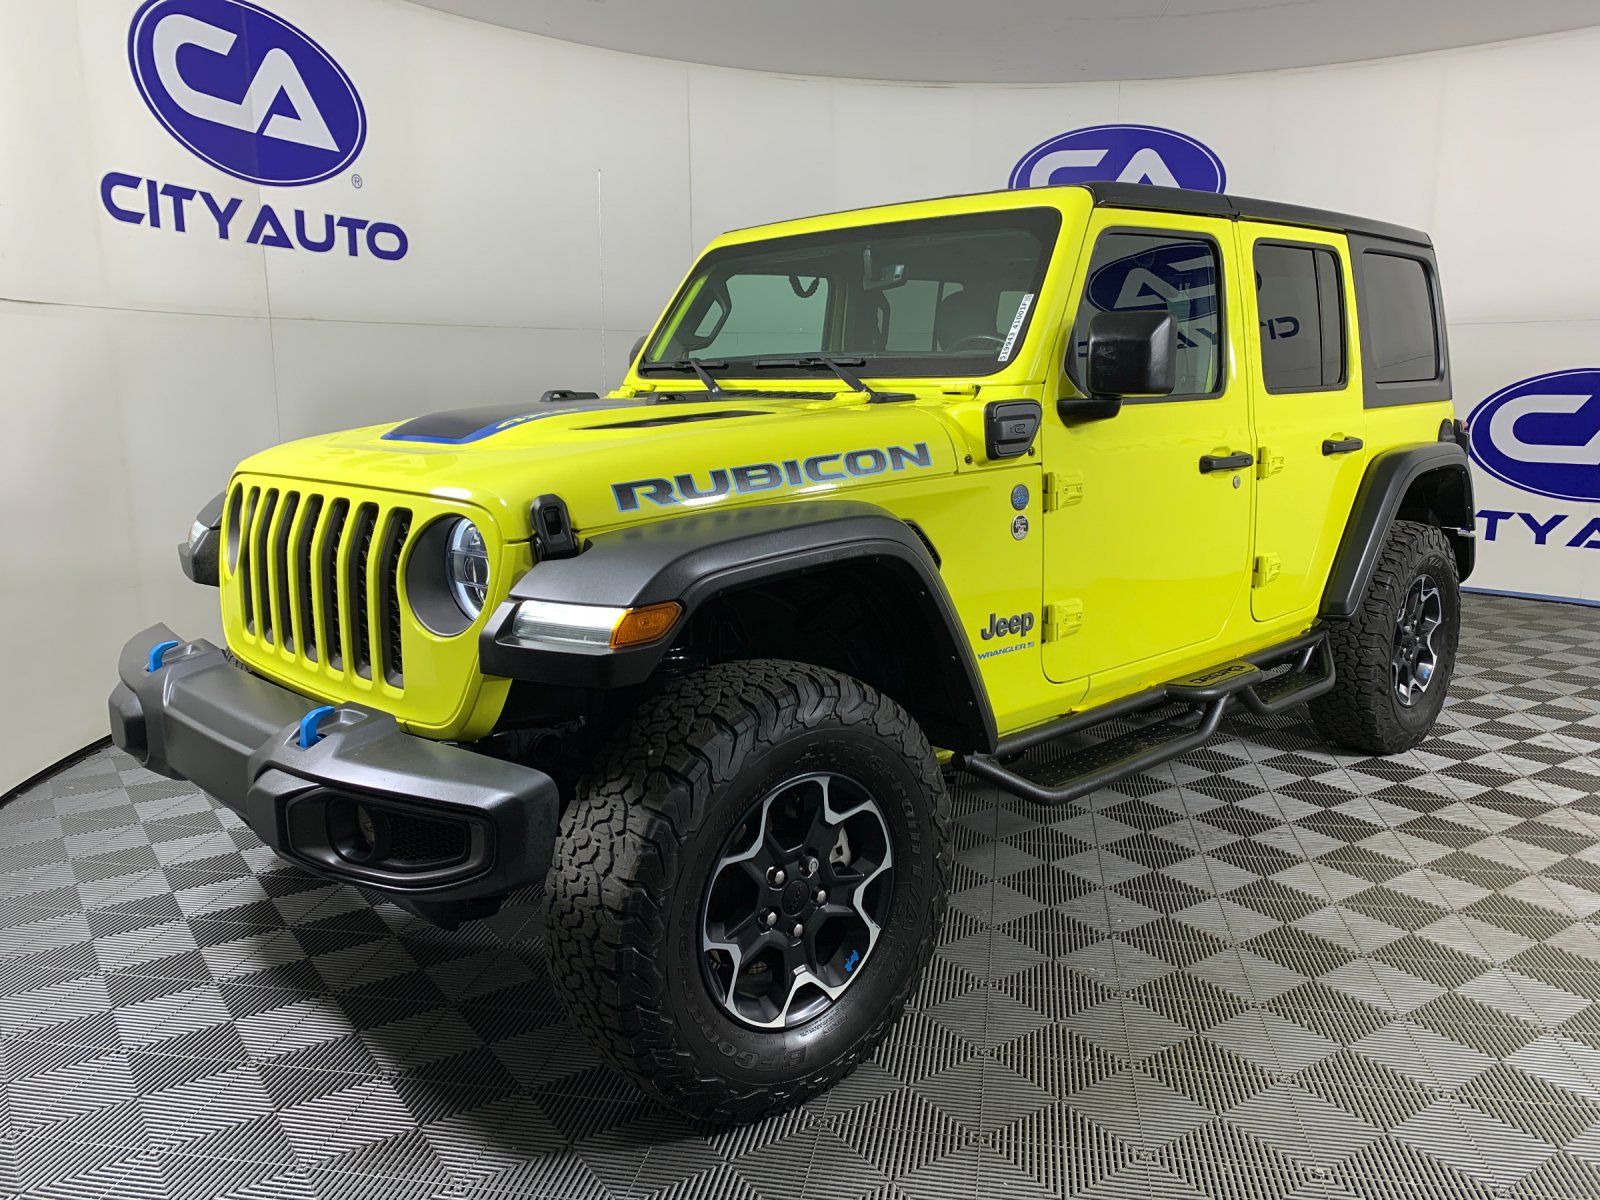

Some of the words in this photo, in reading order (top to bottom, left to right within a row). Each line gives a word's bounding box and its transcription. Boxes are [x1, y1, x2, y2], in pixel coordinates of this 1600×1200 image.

[153, 13, 341, 153] CA
[101, 171, 243, 240] CITY
[246, 204, 410, 261] AUTO
[1489, 394, 1600, 465] C
[611, 441, 932, 513] RUBICON
[977, 643, 1026, 660] WRANGLER
[980, 611, 1035, 641] Jeep
